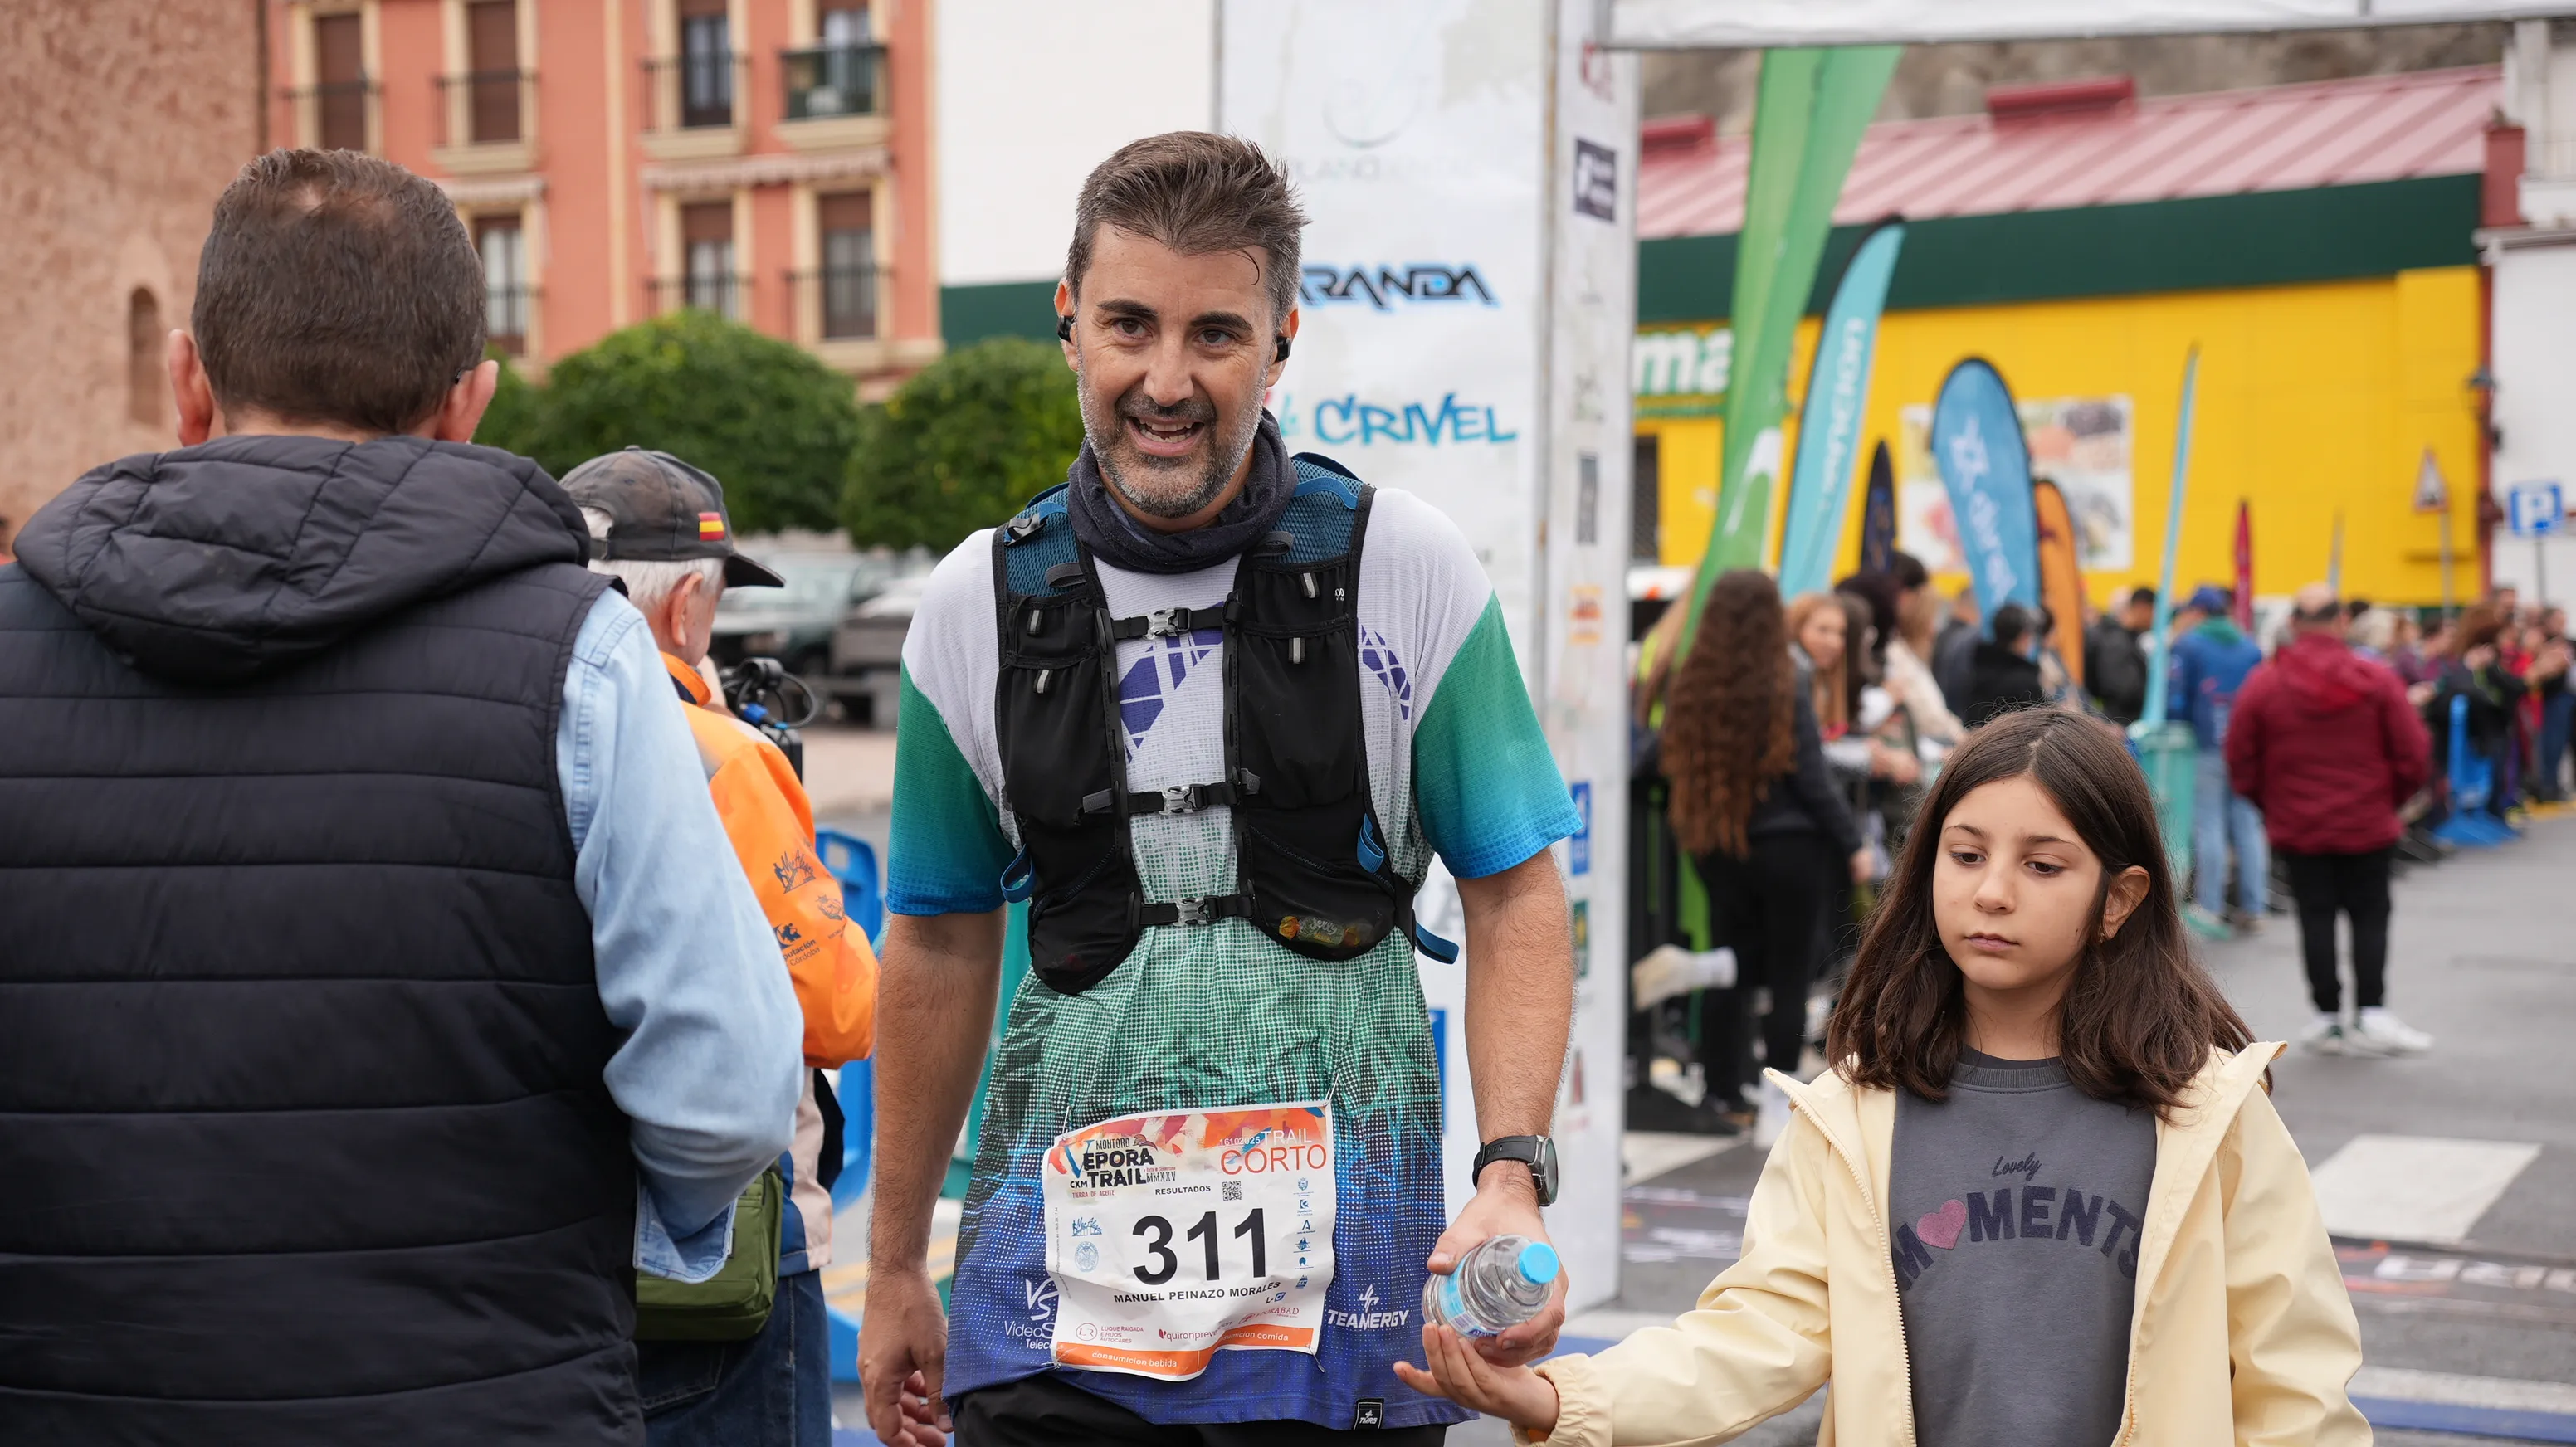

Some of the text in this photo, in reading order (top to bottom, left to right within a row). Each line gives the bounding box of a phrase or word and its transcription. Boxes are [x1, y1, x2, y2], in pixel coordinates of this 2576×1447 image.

[1300, 263, 1499, 310] RANDA
[2520, 490, 2554, 529] P
[789, 948, 821, 967] Córdoba
[1095, 1138, 1130, 1150] MONTORO
[1261, 1128, 1312, 1146] TRAIL
[1083, 1148, 1154, 1171] EPORA
[1221, 1144, 1327, 1175] CORTO
[1992, 1152, 2042, 1181] Lovely
[1070, 1167, 1176, 1189] CXM TRAIL MMXXV
[1155, 1185, 1211, 1196] RESULTADOS
[1132, 1207, 1266, 1286] 311
[1114, 1281, 1281, 1303] MANUEL PEINAZO MORALES
[1026, 1338, 1052, 1350] Telec
[1256, 1332, 1289, 1342] comida
[1092, 1352, 1177, 1367] consumicion bebida
